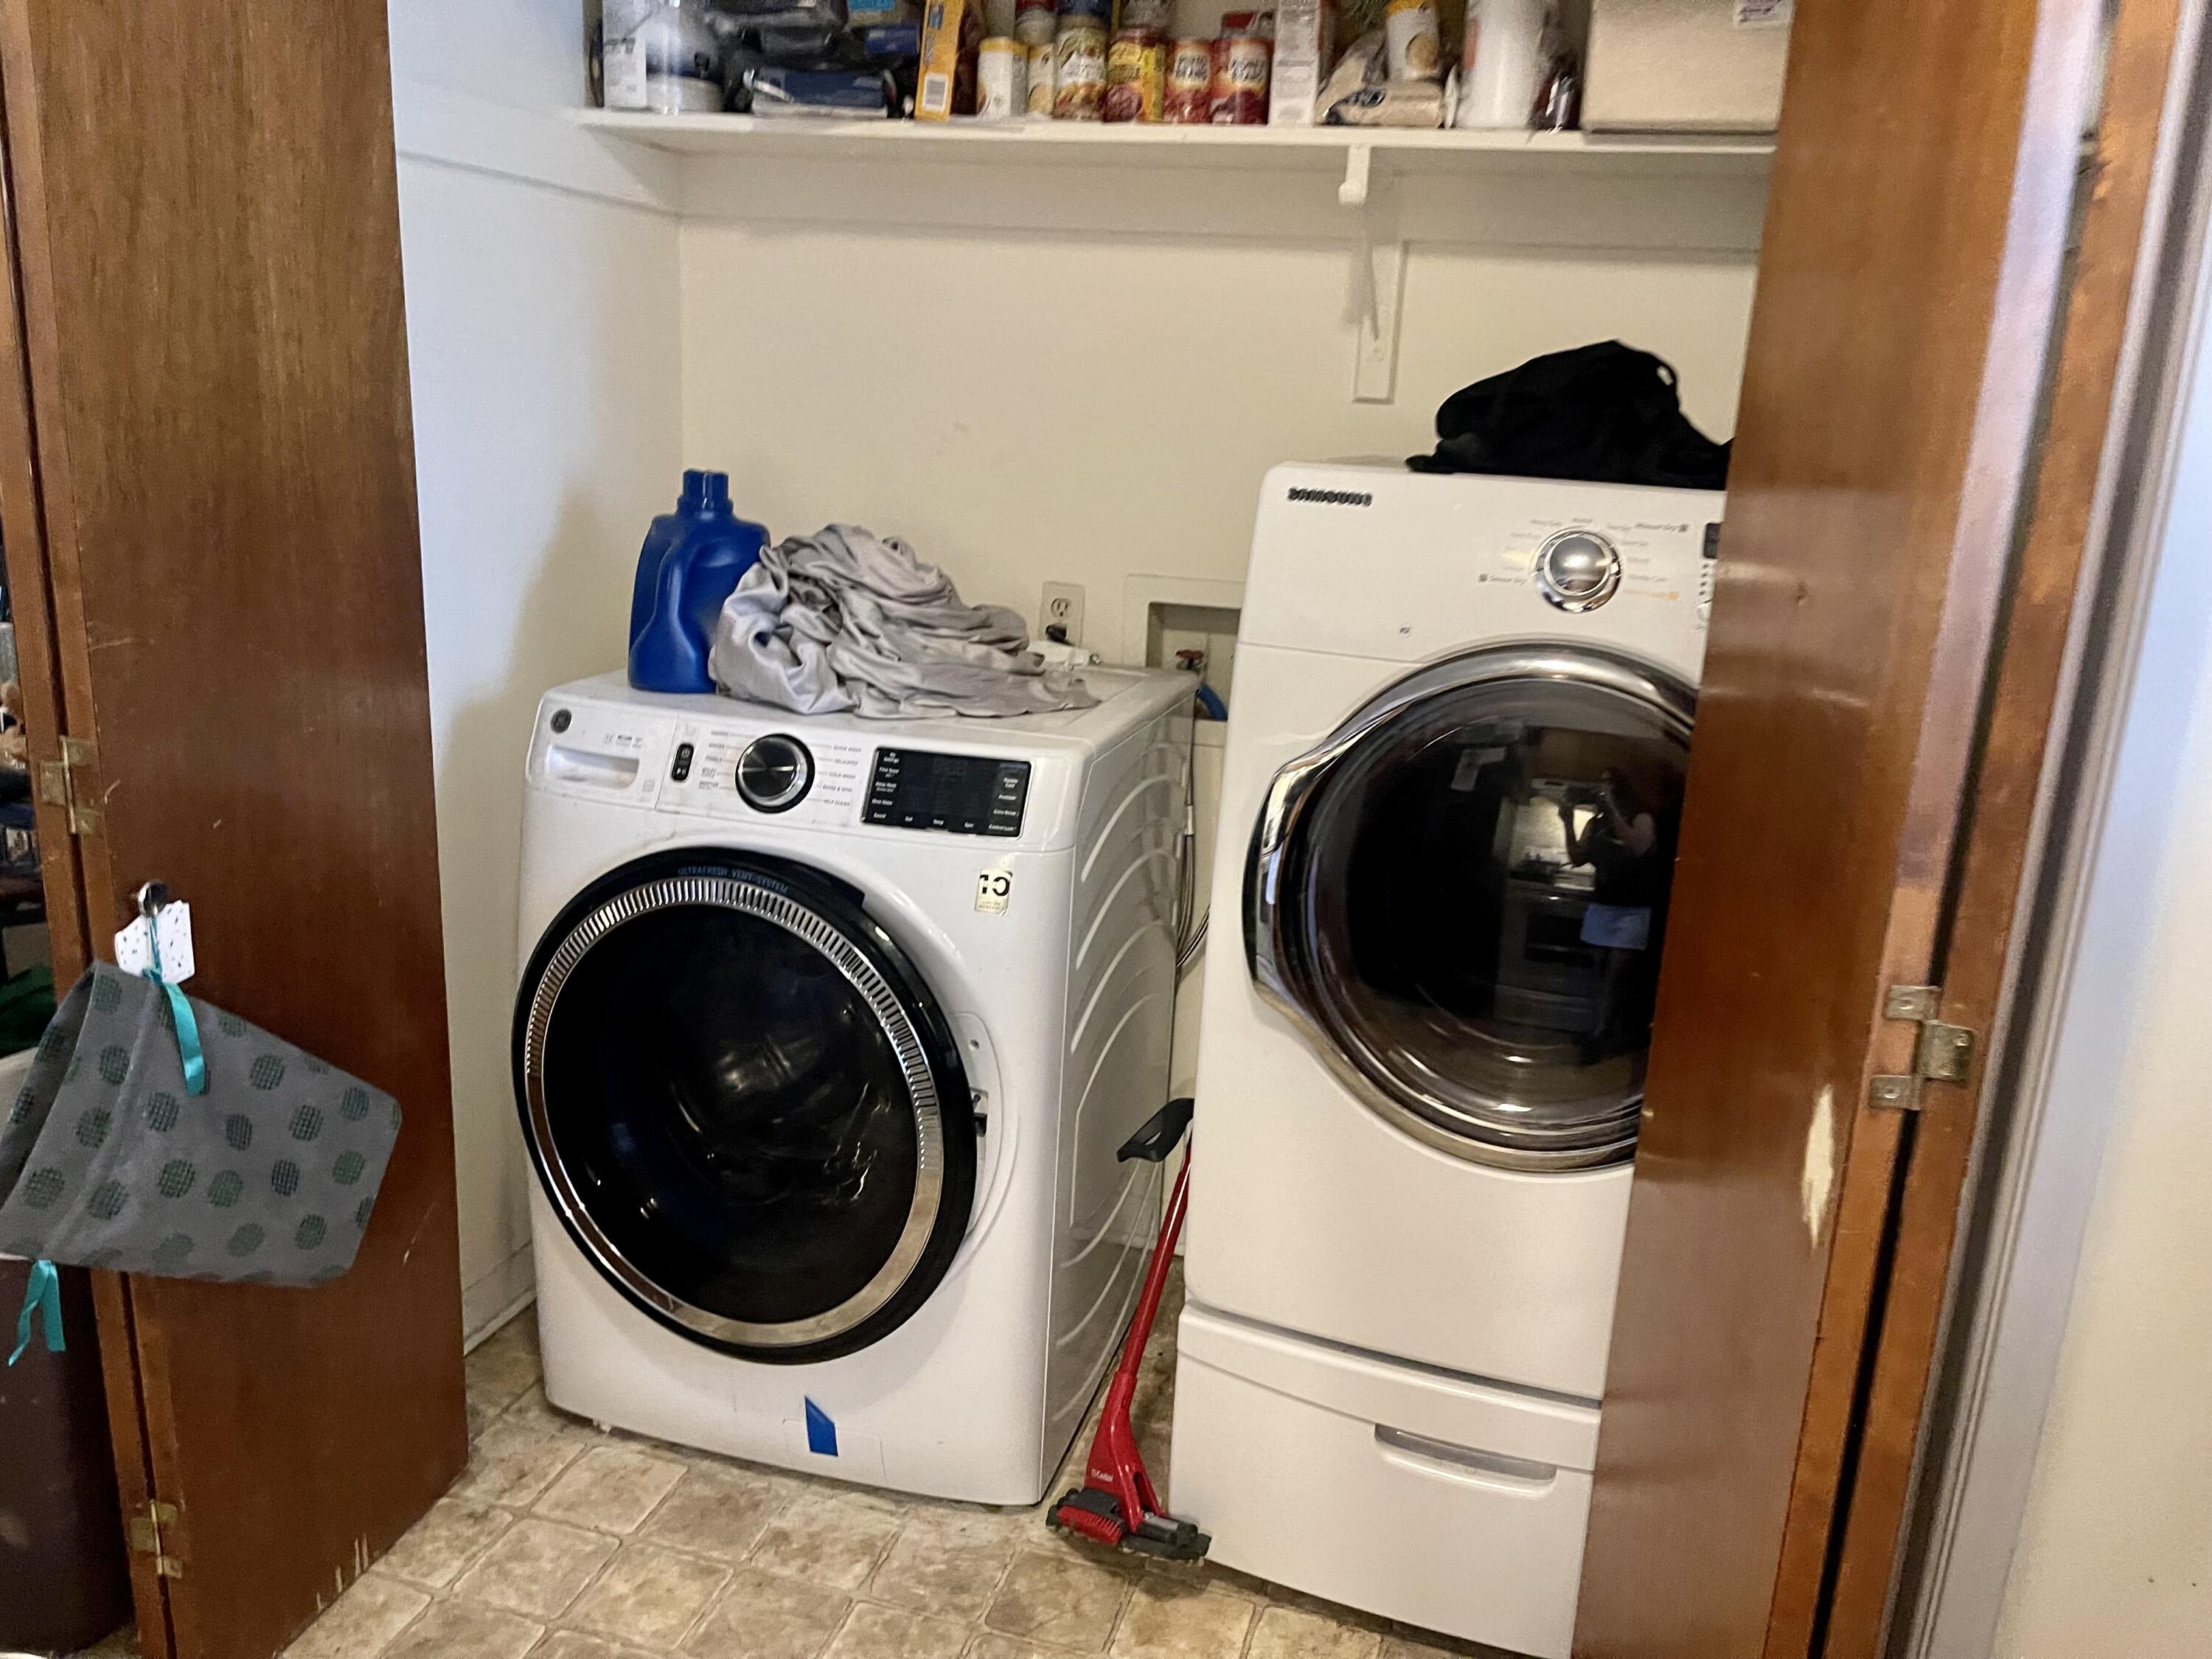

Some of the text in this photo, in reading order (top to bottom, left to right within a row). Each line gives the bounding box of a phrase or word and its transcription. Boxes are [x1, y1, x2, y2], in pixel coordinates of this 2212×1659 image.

[678, 865, 790, 894] ULTRAFRESH VENT SYSTEM
